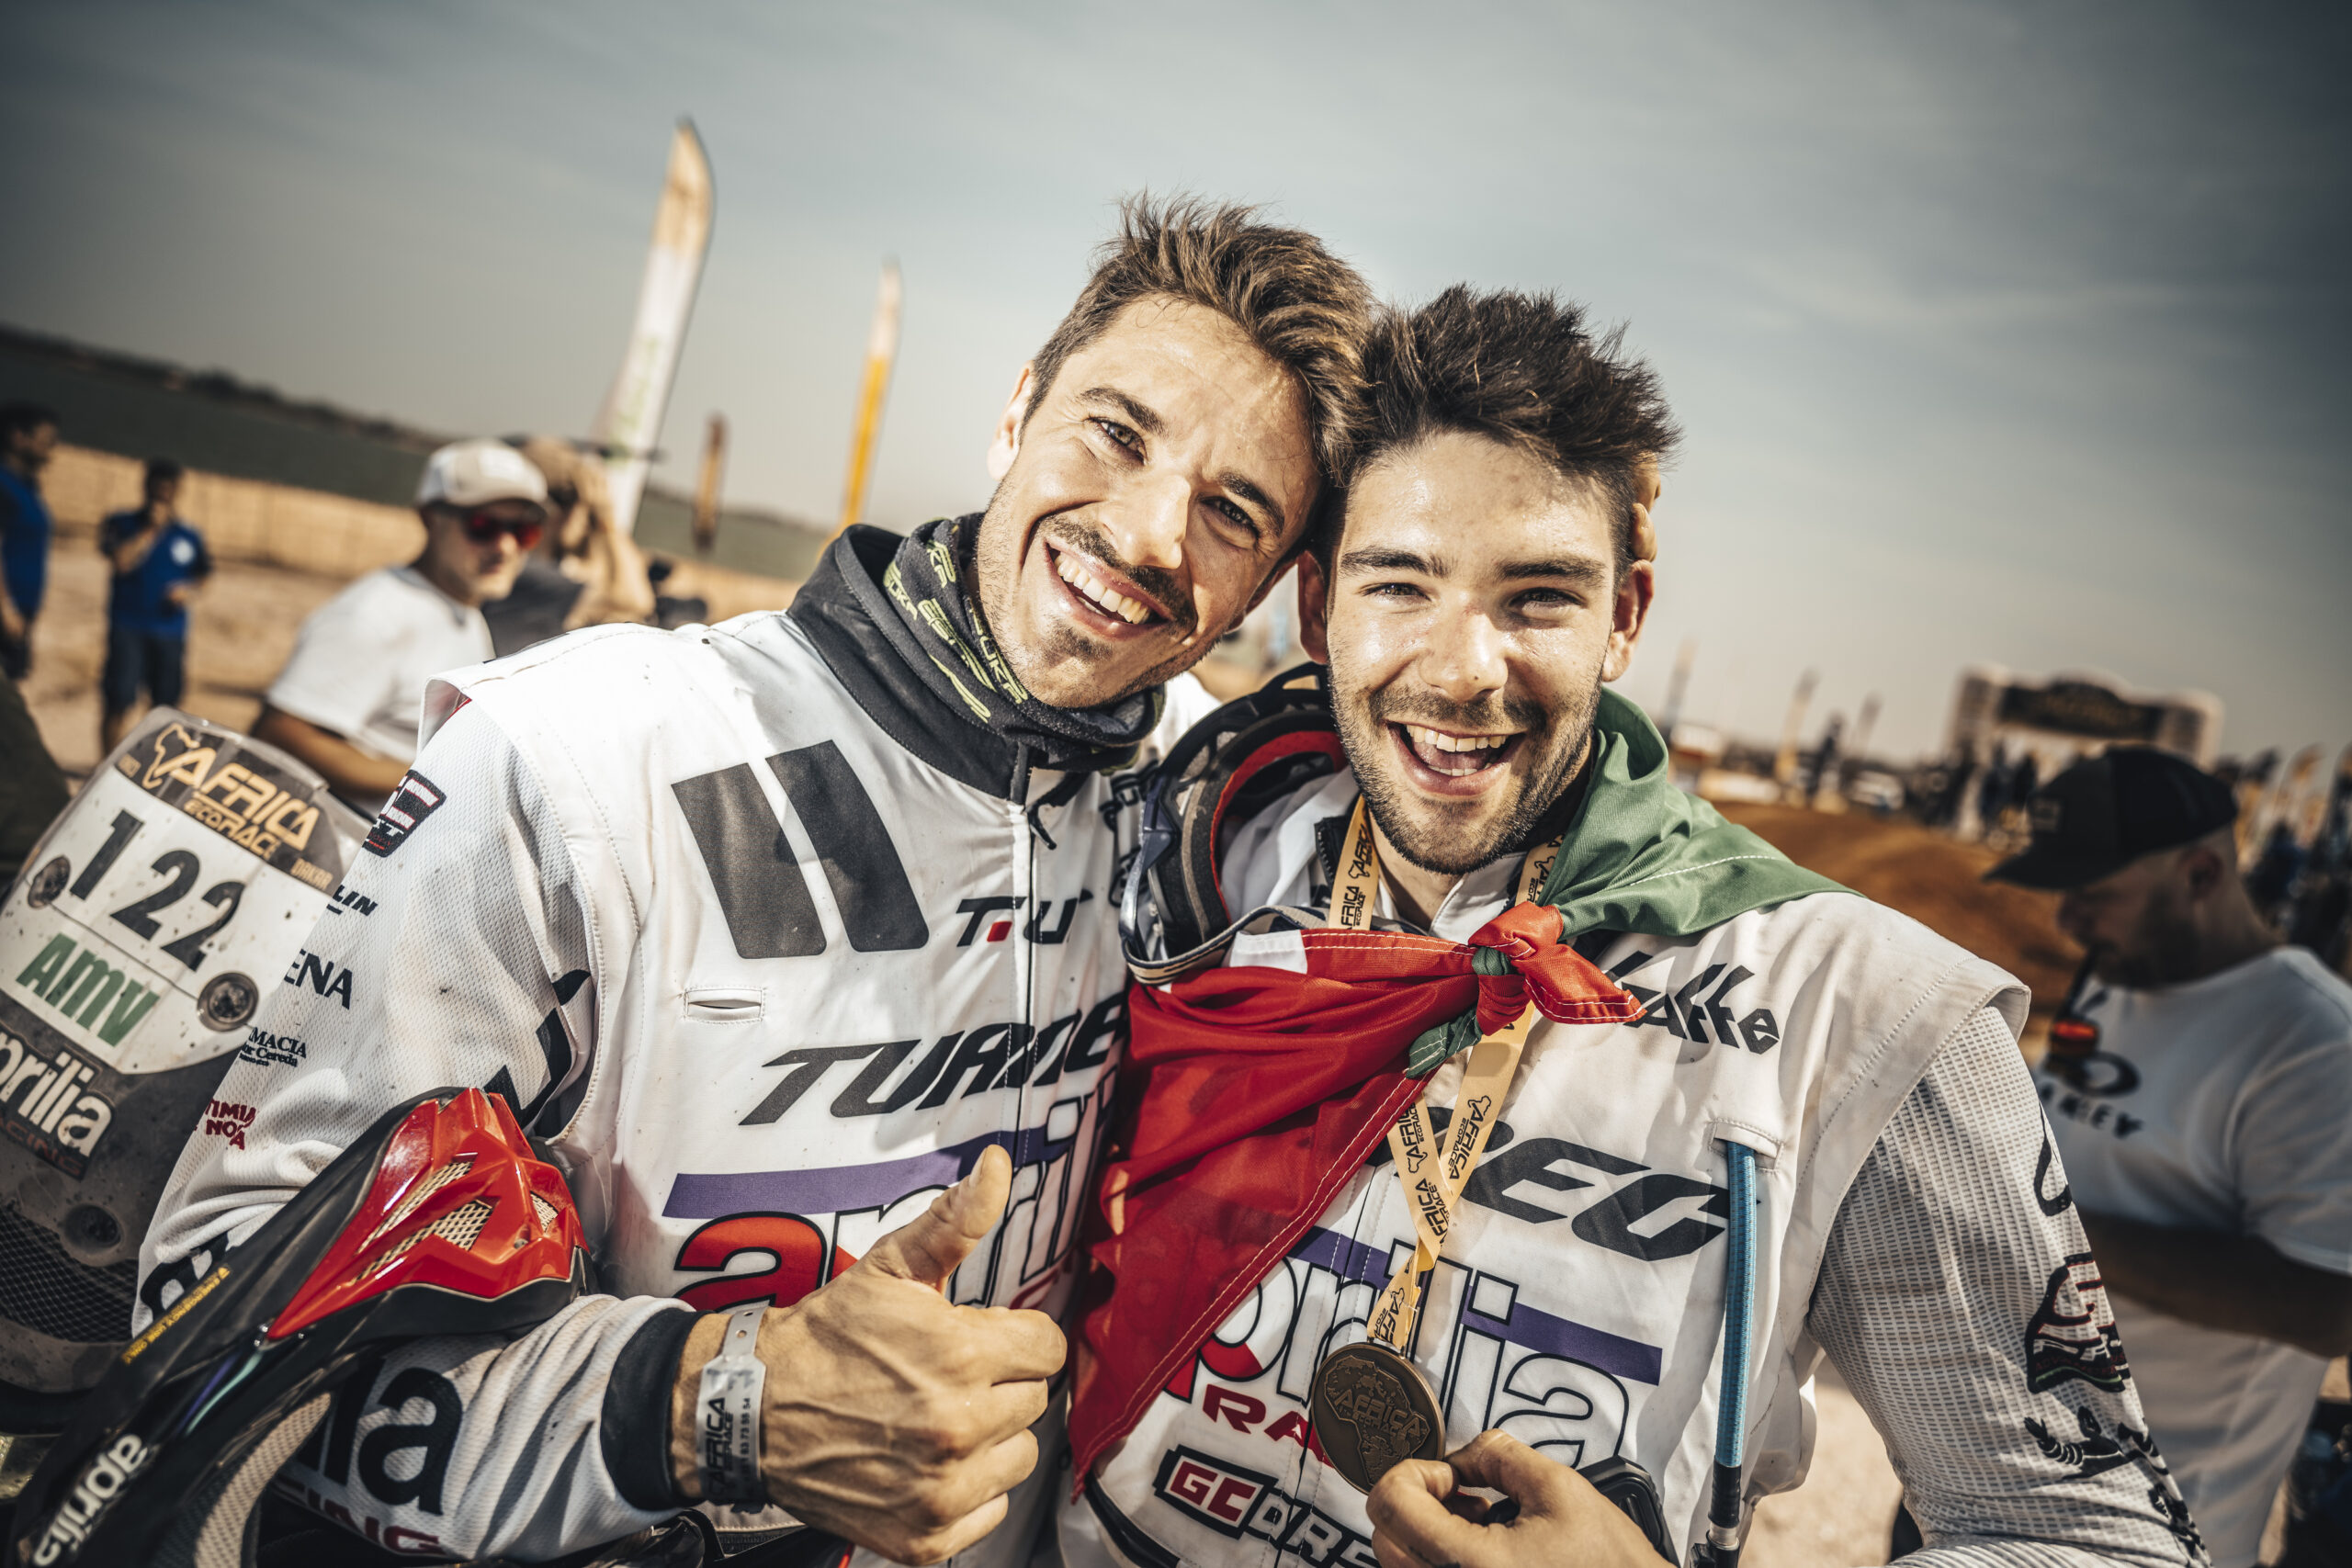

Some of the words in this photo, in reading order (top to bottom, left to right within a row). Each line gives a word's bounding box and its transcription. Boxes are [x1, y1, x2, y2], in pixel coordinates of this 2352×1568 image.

[153, 748, 320, 852] AFRICA
[185, 798, 281, 861] ECORACE
[69, 808, 246, 972] 122
[1341, 886, 1360, 929] FRICA
[1449, 1102, 1484, 1180] AFRICA
[1416, 1178, 1449, 1245] FRICA
[706, 1396, 726, 1484] AFRICA
[1334, 1388, 1420, 1438] AFRICA
